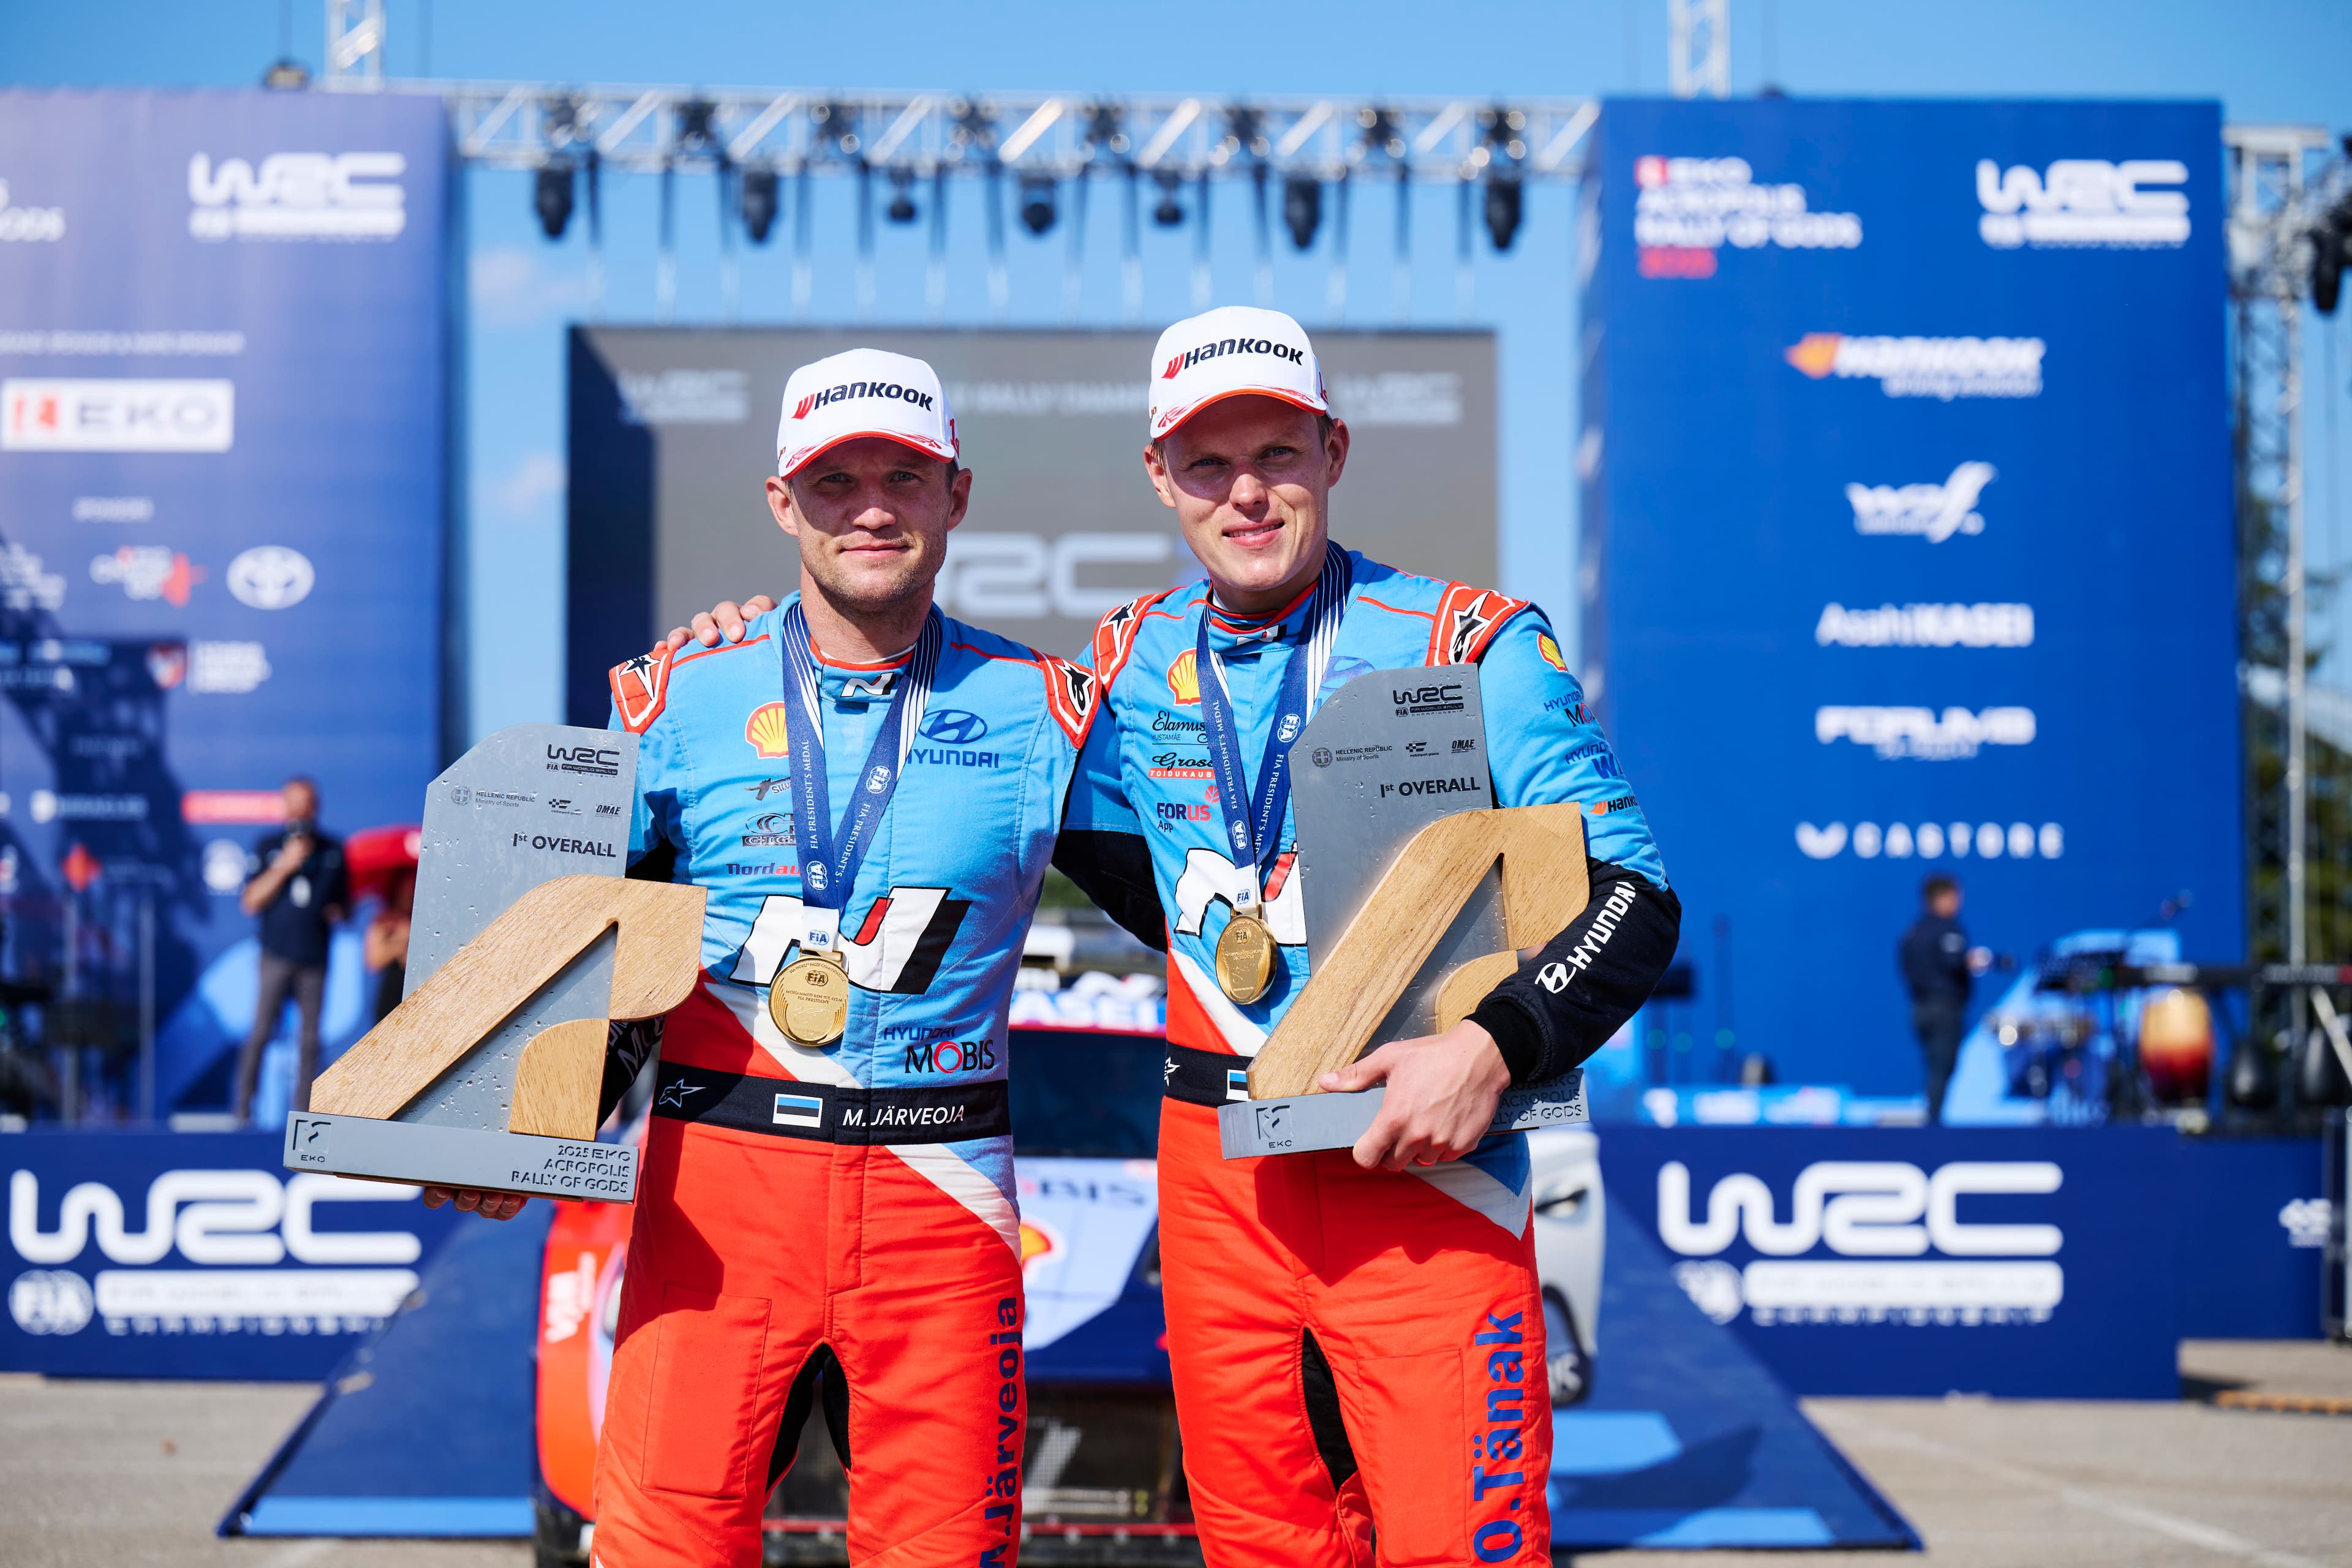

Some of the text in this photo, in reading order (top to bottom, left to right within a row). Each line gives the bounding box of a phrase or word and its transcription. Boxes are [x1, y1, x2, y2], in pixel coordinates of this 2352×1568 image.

[933, 533, 1172, 617] RC
[1393, 685, 1463, 704] WRC
[1544, 690, 1581, 712] HYUNDA
[547, 744, 620, 766] WRC
[1399, 777, 1480, 796] OVERALL
[1157, 802, 1211, 821] FORUS
[1158, 820, 1174, 833] App
[532, 835, 616, 858] OVERALL
[1566, 881, 1637, 970] HYUNDAI
[884, 1026, 957, 1041] HYUNDAI
[905, 1039, 995, 1074] MOBIS
[1501, 1089, 1580, 1108] ACROPOLIS
[870, 1105, 964, 1126] JÄRVEOJA
[1518, 1109, 1537, 1121] OF
[1541, 1104, 1582, 1119] GODS
[301, 1154, 326, 1163] EKO
[558, 1145, 631, 1161] 2025 EKO
[544, 1158, 630, 1177] ACROPOLIS
[511, 1170, 628, 1193] RALLY OF GODS
[10, 1169, 421, 1264] WRC
[1657, 1161, 2064, 1256] WRC
